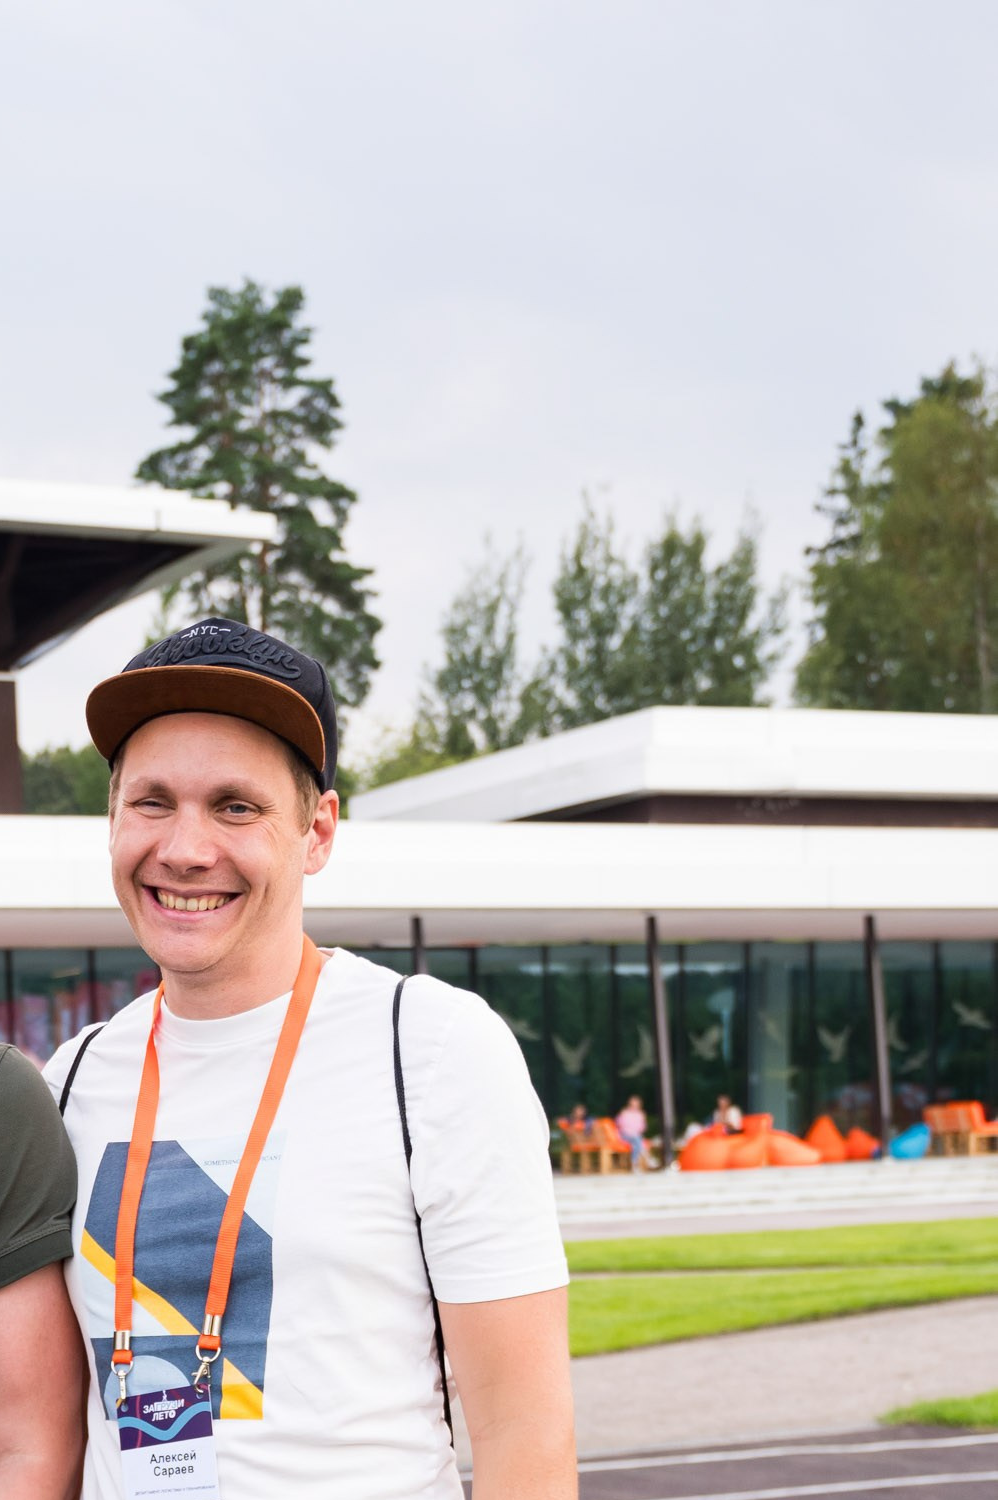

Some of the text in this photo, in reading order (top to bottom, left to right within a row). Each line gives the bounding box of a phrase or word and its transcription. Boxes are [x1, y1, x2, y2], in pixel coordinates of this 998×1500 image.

[143, 1398, 185, 1414] ЗАГРУЗИ
[152, 1409, 176, 1422] ЛЕТО
[150, 1450, 197, 1464] Алексей
[153, 1464, 194, 1478] Сараев
